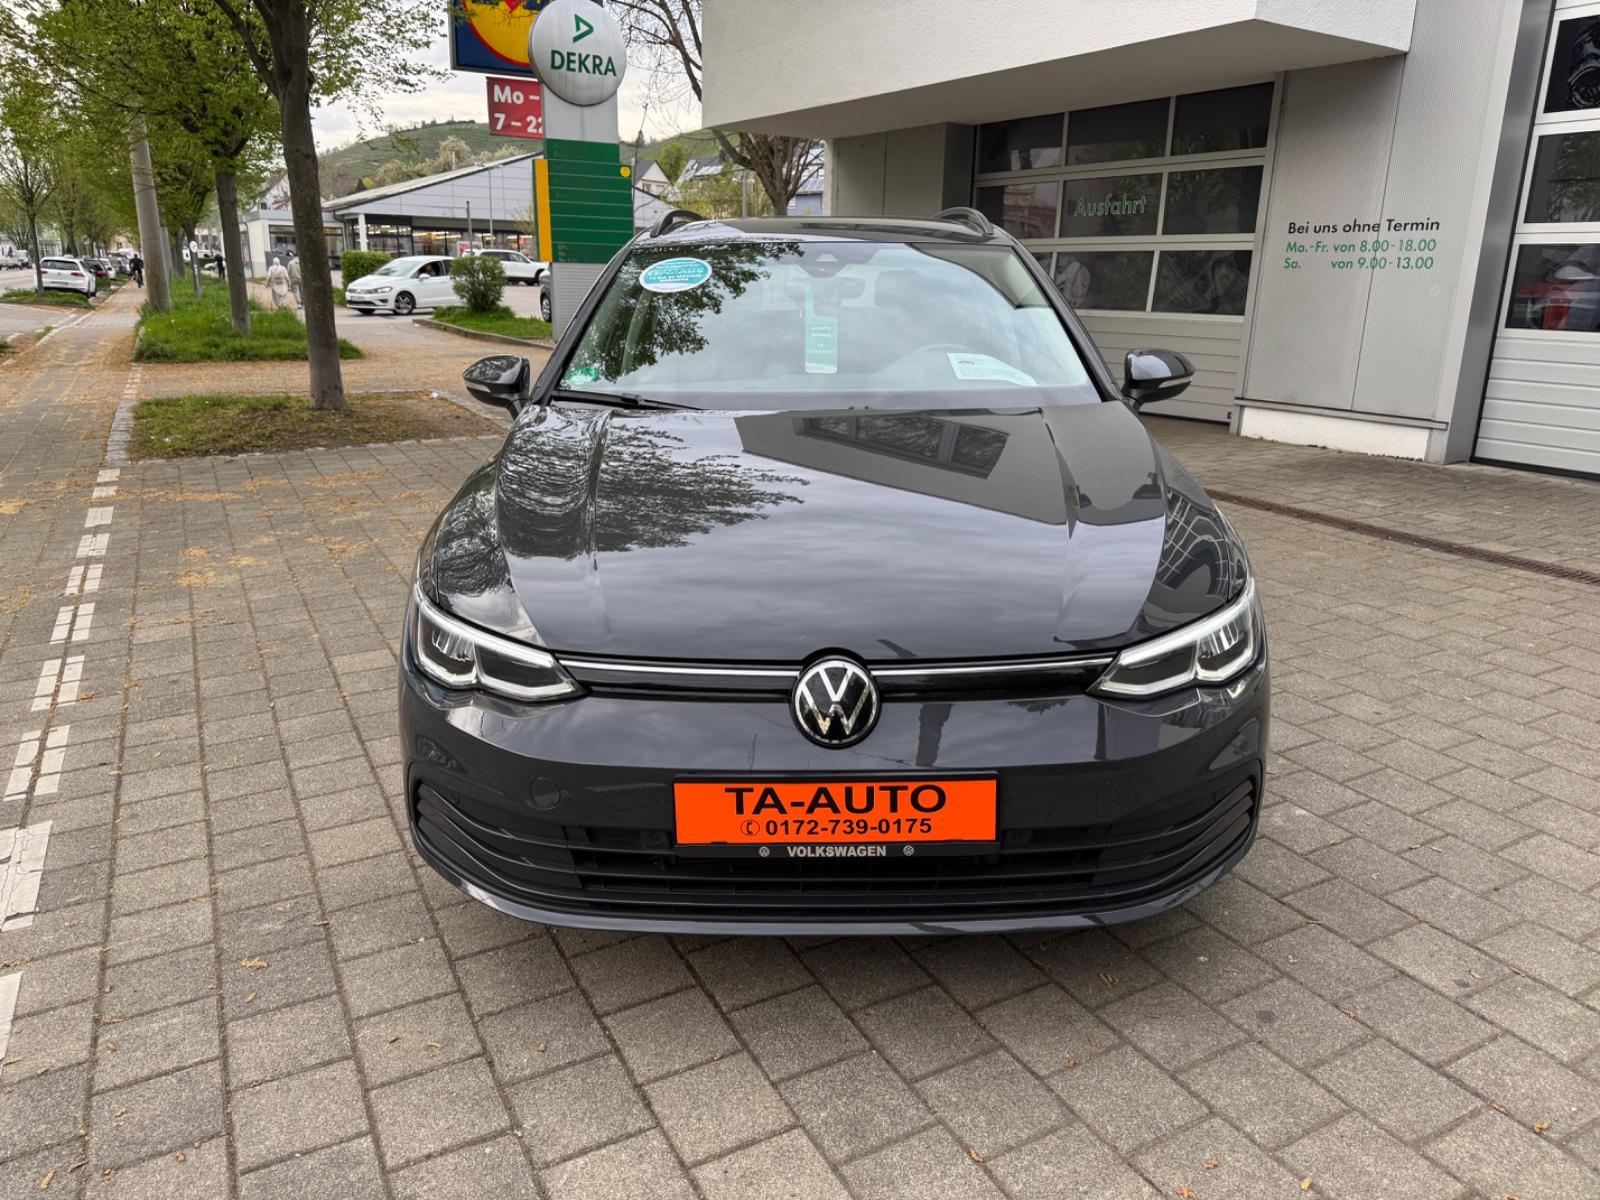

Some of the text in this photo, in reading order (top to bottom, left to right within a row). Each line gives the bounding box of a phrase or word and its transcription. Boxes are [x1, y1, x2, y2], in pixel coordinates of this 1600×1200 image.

[550, 49, 617, 77] DEKRA
[493, 84, 524, 105] Mo
[494, 112, 506, 130] 7
[1074, 192, 1148, 217] Ausfahrt
[1288, 217, 1440, 234] Bei uns ohne Termin
[1333, 242, 1355, 253] von
[1284, 257, 1302, 269] Sa.
[1331, 259, 1353, 269] von
[724, 784, 947, 815] TA-AUTO
[765, 818, 932, 836] 0172-739-0175
[787, 845, 887, 858] VOLKSWAGEN
